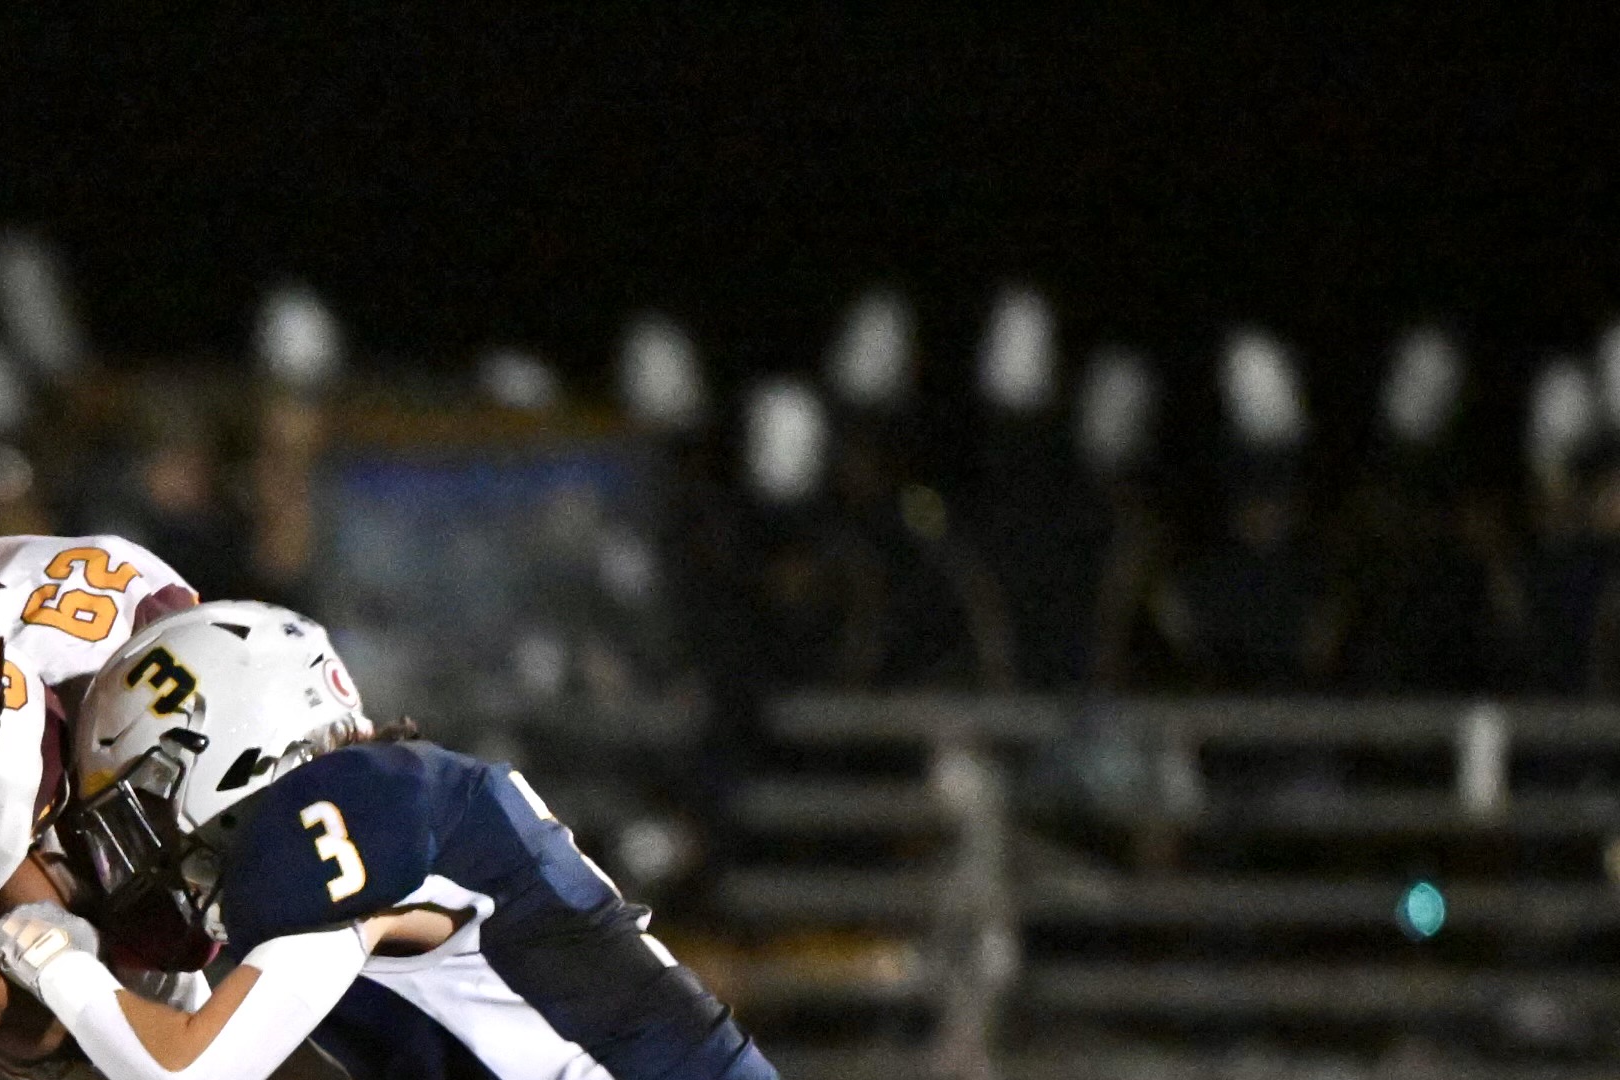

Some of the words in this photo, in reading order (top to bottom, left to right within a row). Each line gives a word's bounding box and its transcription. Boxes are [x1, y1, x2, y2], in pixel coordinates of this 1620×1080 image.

[21, 546, 143, 642] 62
[126, 646, 198, 716] 3
[300, 801, 366, 902] 3
